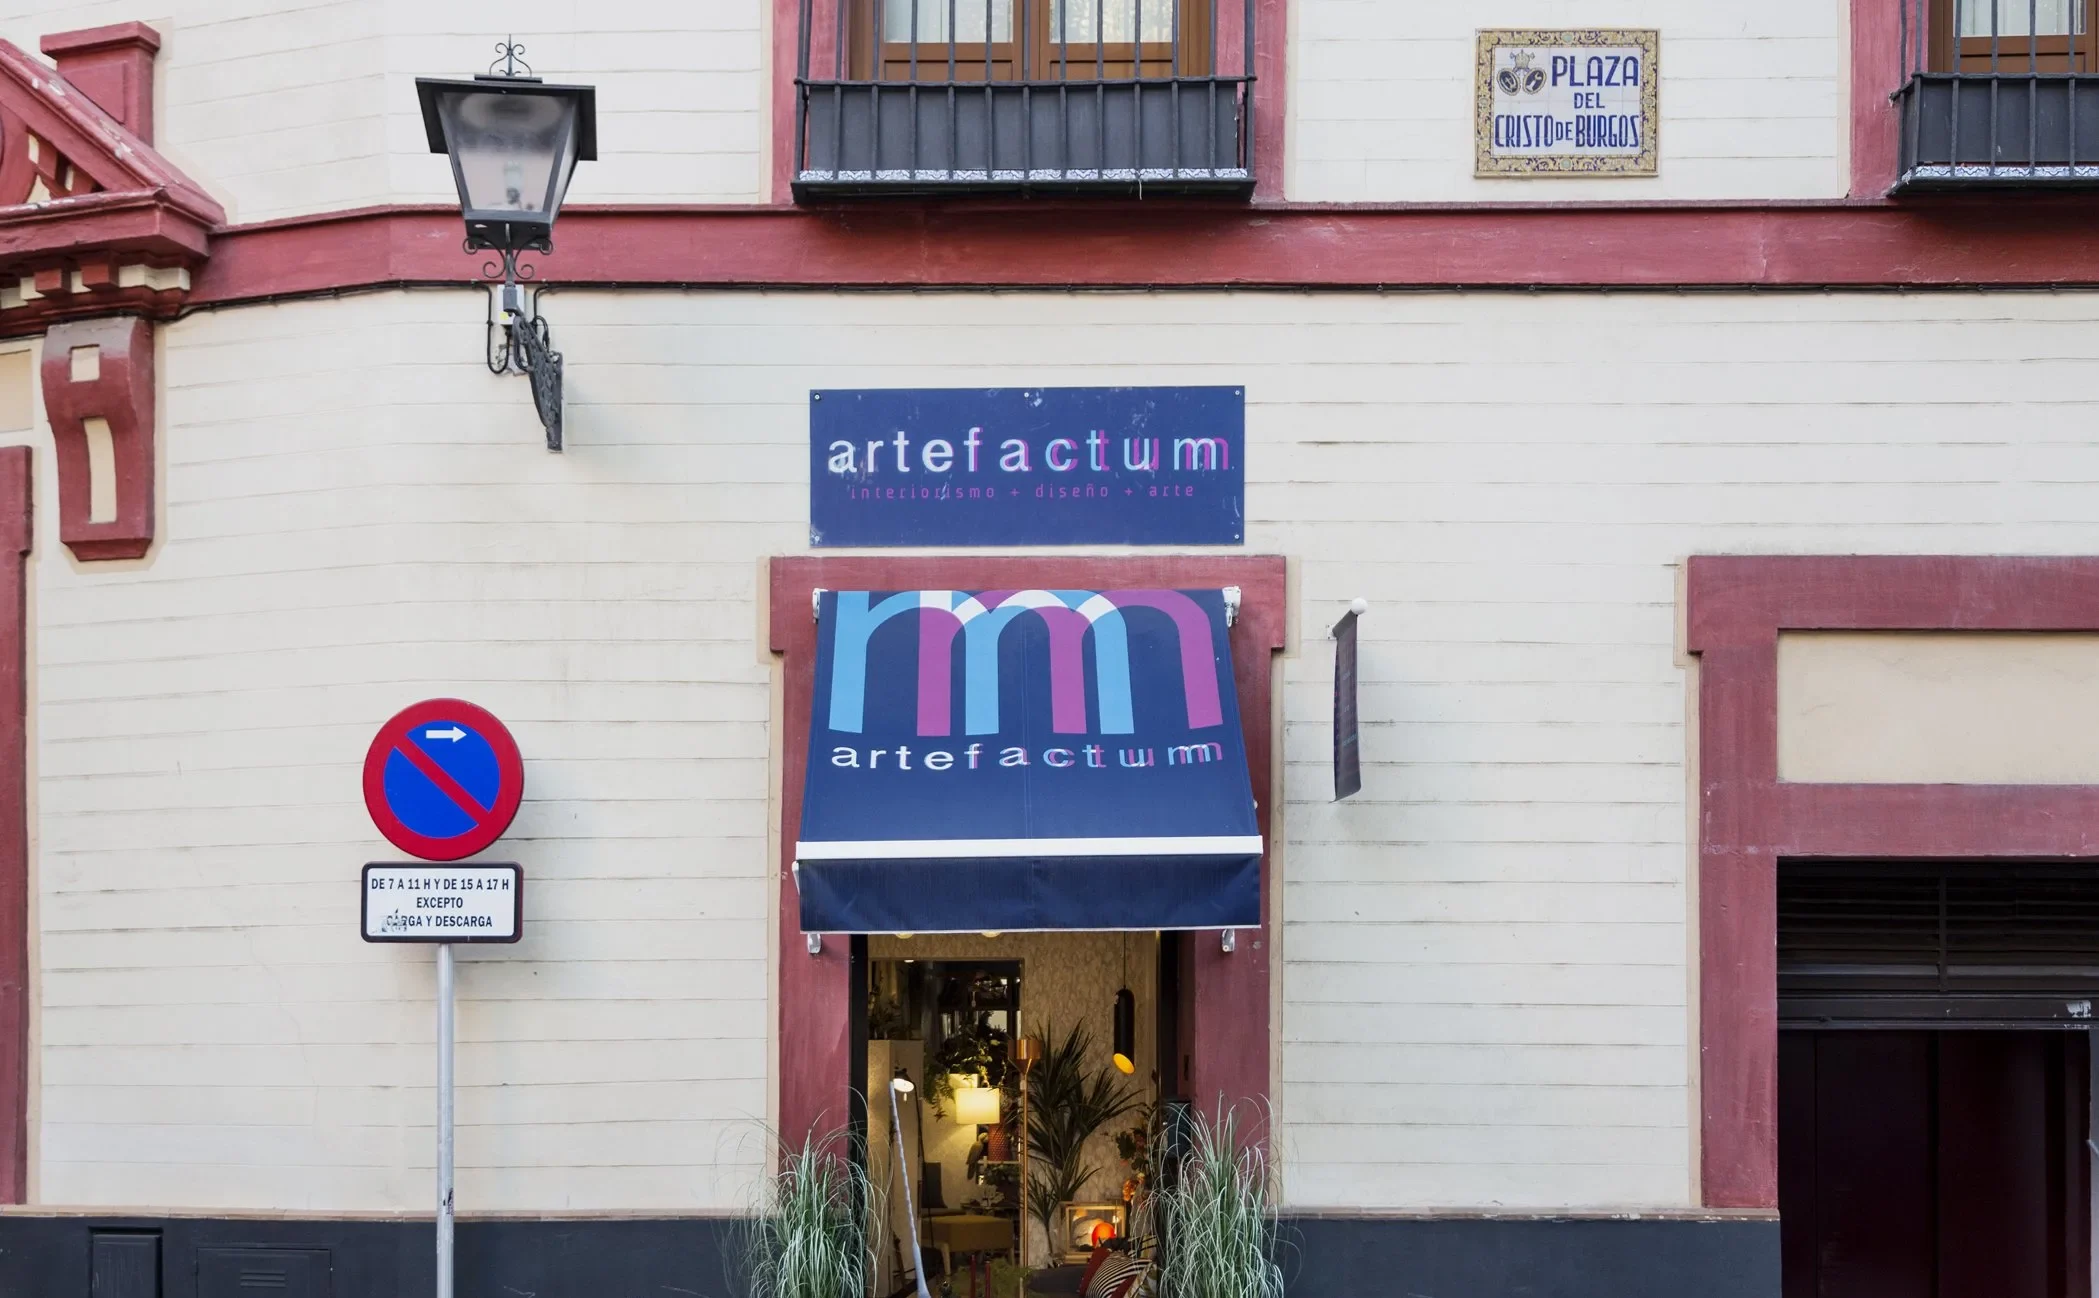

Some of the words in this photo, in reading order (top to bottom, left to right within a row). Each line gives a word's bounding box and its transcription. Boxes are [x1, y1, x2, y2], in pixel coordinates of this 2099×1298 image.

[1551, 55, 1639, 87] PLAZA
[1573, 92, 1605, 109] DEL
[1494, 114, 1554, 148] CRISTO
[1555, 121, 1574, 141] DE
[1575, 114, 1639, 148] BURGOS
[828, 427, 1229, 473] artefactum
[851, 483, 995, 499] interiorismo
[1035, 482, 1109, 498] diseño
[1149, 484, 1194, 498] arte
[831, 740, 1223, 770] artefactum
[371, 878, 385, 890] DE
[388, 878, 395, 890] 7
[397, 878, 405, 890] A
[407, 878, 421, 890] 11
[423, 878, 431, 890] H
[433, 878, 441, 890] Y
[443, 878, 457, 890] DE
[460, 878, 473, 890] 15
[476, 878, 484, 890] A
[486, 878, 499, 890] 17
[502, 878, 510, 890] H
[416, 897, 464, 908] EXCEPTO
[425, 915, 433, 927] Y
[435, 915, 493, 927] DESCARGA
